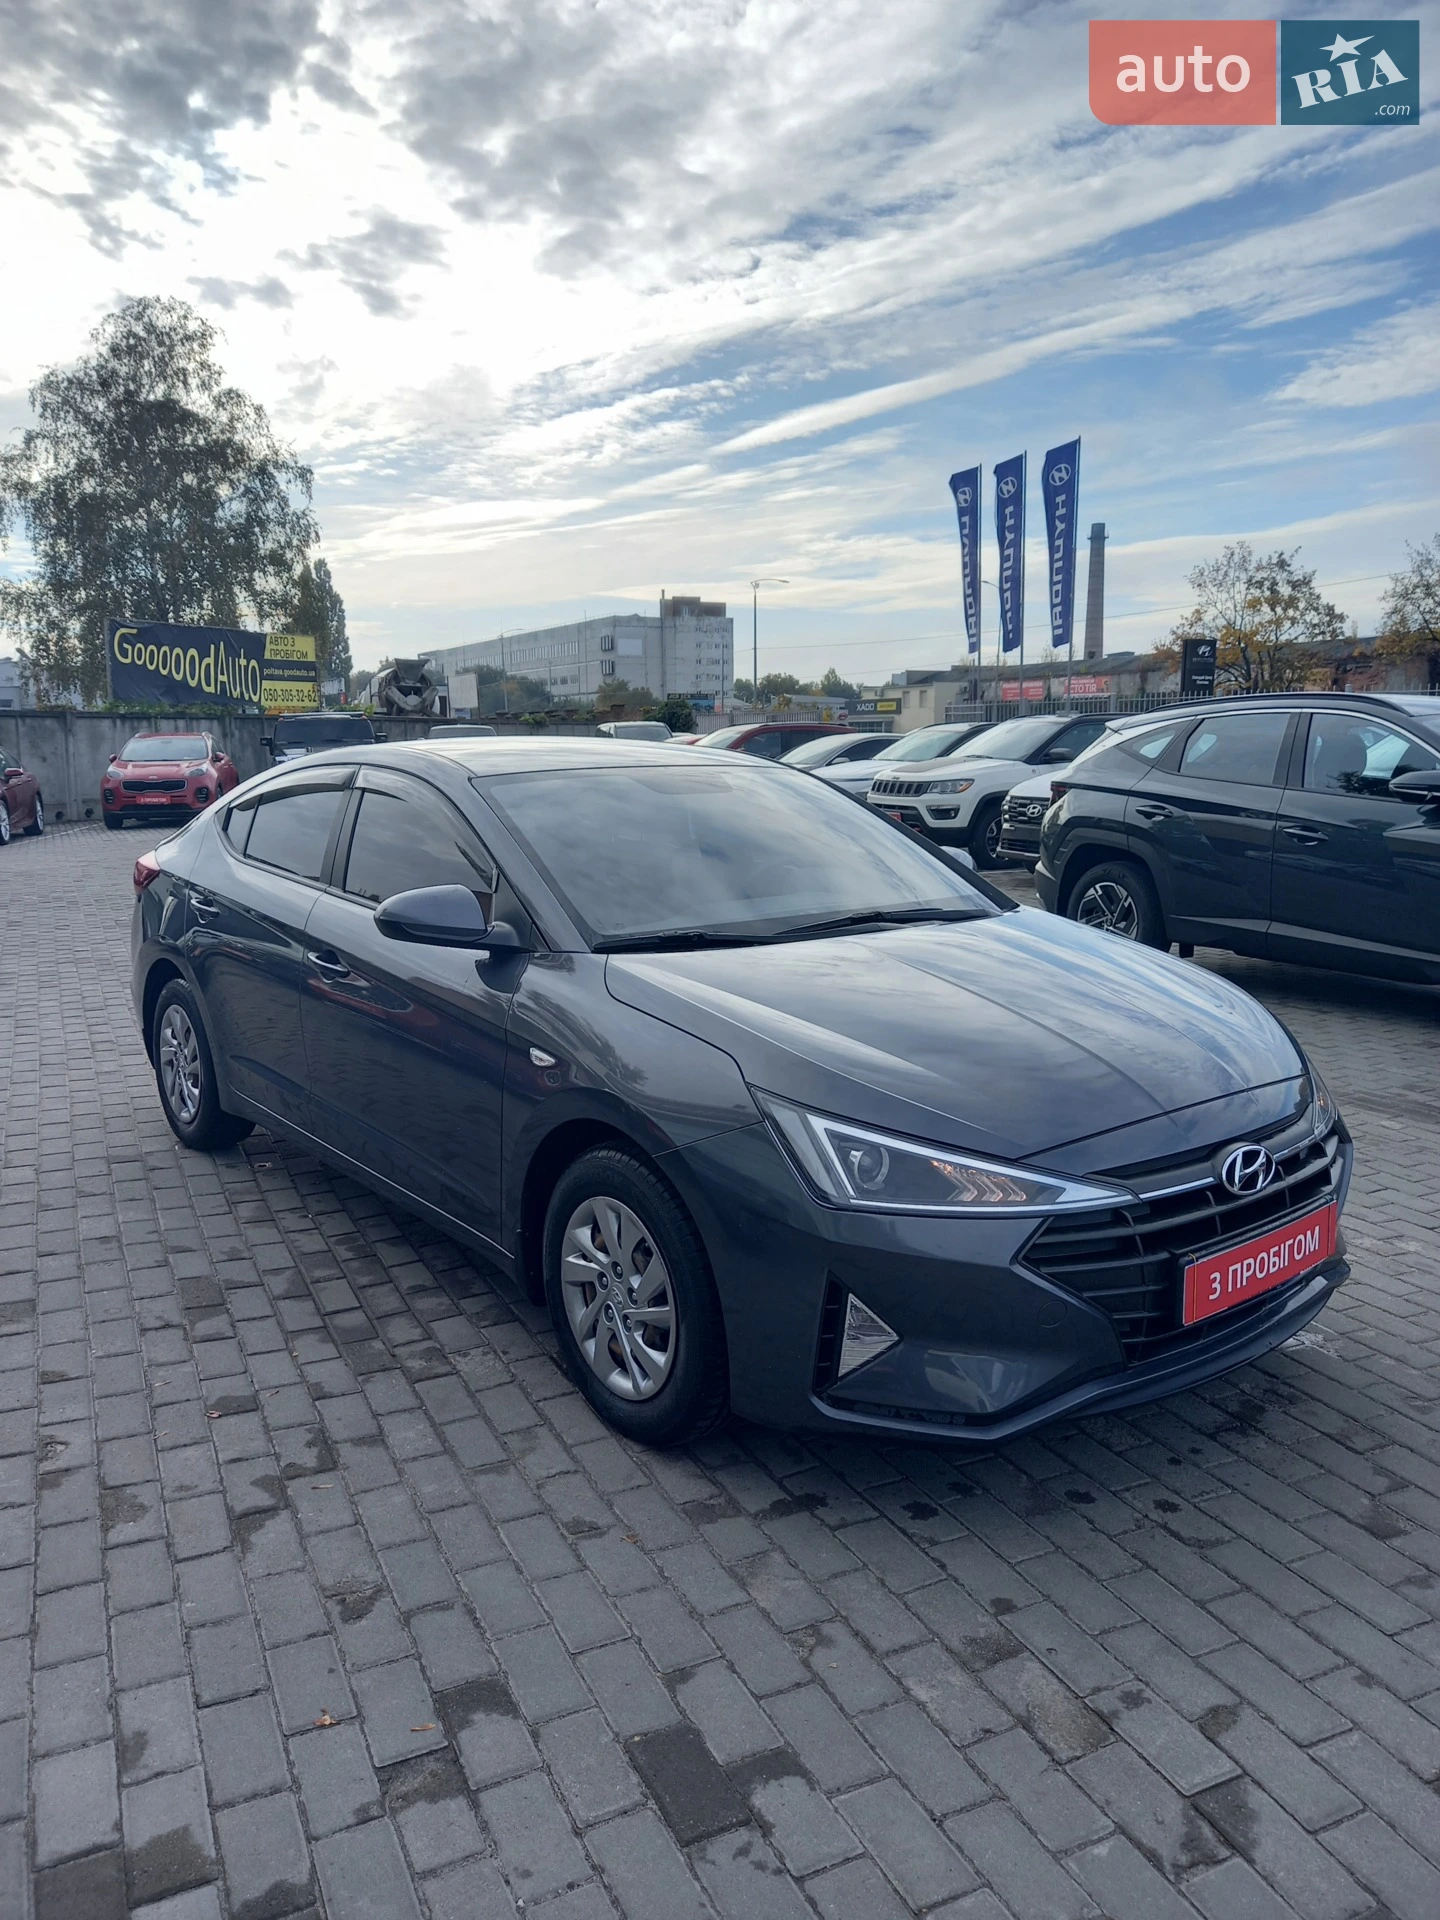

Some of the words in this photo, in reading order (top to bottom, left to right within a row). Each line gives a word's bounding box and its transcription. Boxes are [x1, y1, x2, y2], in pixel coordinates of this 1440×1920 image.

[269, 635, 289, 647] АВТО
[270, 648, 309, 660] ПРОБІГОМ
[263, 667, 316, 677] poltava.goodauto.ua
[263, 687, 317, 702] 050-305-32-62
[856, 702, 875, 711] XADO
[1208, 1271, 1221, 1300] З
[1227, 1225, 1320, 1292] ПРОБІГОМ
